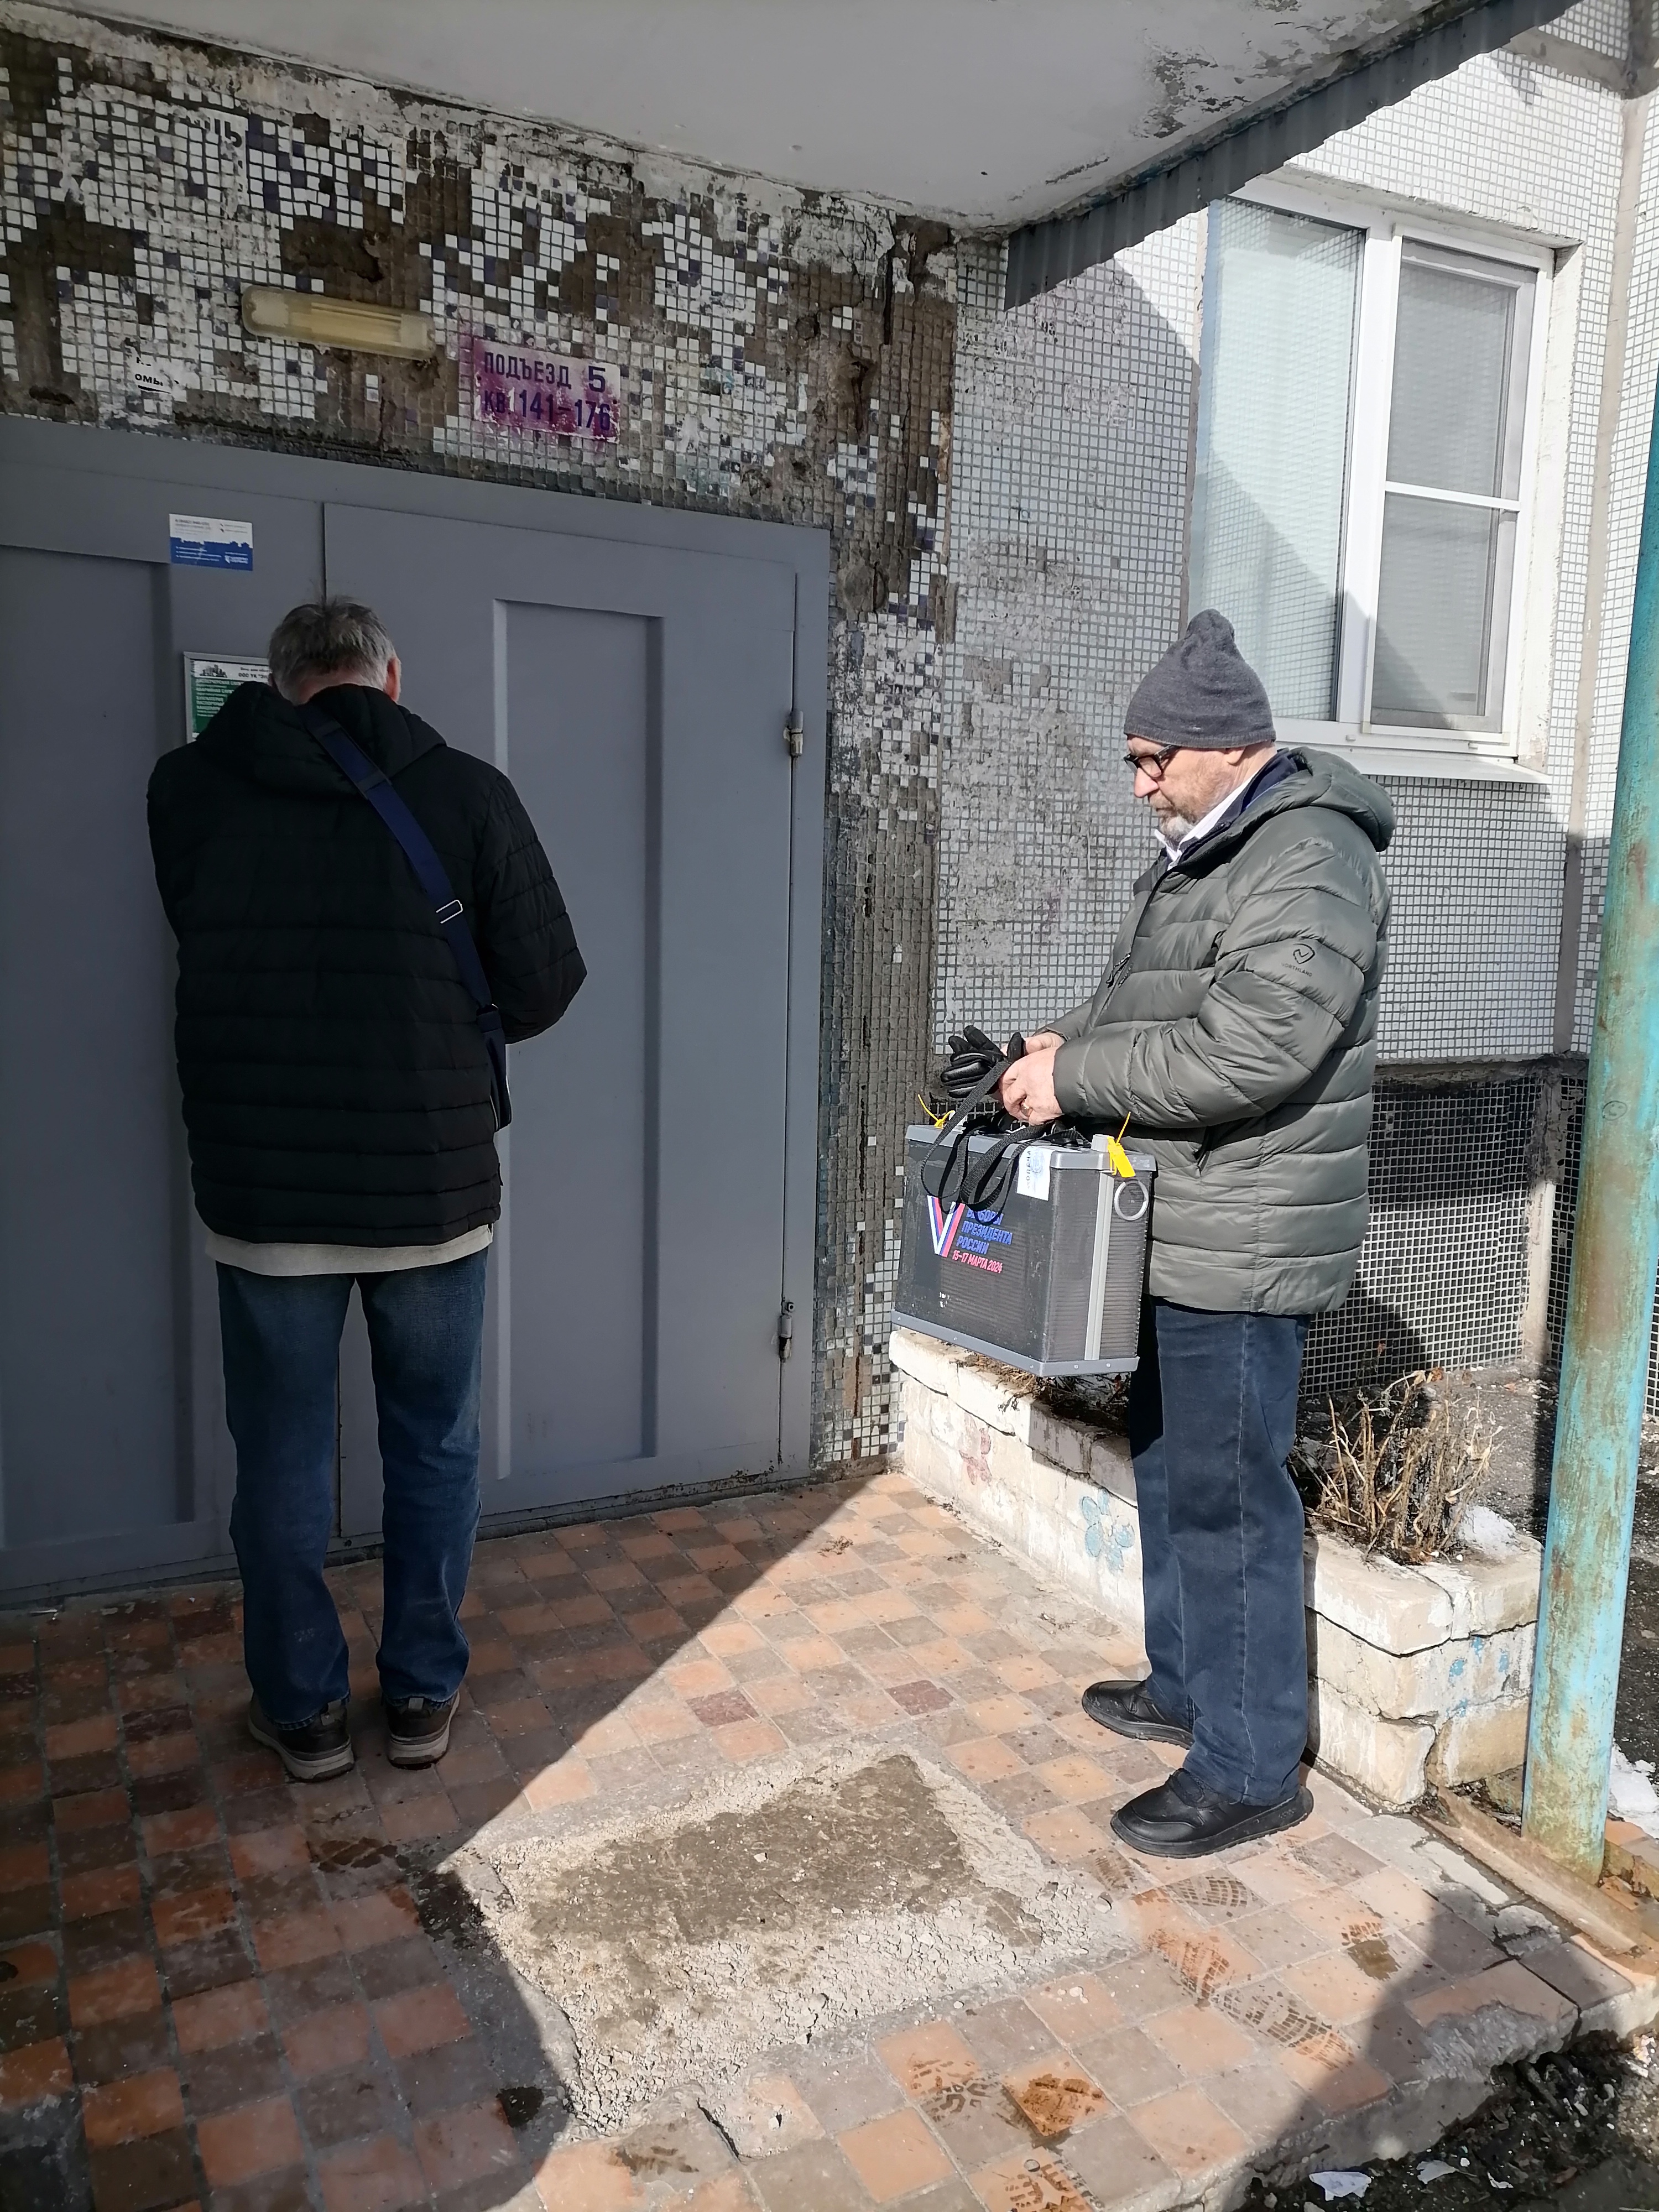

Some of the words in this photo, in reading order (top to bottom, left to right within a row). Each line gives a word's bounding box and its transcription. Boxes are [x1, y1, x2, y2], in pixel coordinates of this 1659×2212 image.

[484, 352, 572, 389] ПОДЪЕЗД
[588, 366, 606, 393] 5
[519, 389, 611, 431] 141-176
[956, 1235, 989, 1255] РОССИИ
[961, 1220, 1013, 1245] ПРЕЗИДЕНТА
[952, 1249, 969, 1264] 15-17
[967, 1254, 988, 1270] МАРТА
[987, 1260, 1003, 1274] 2024
